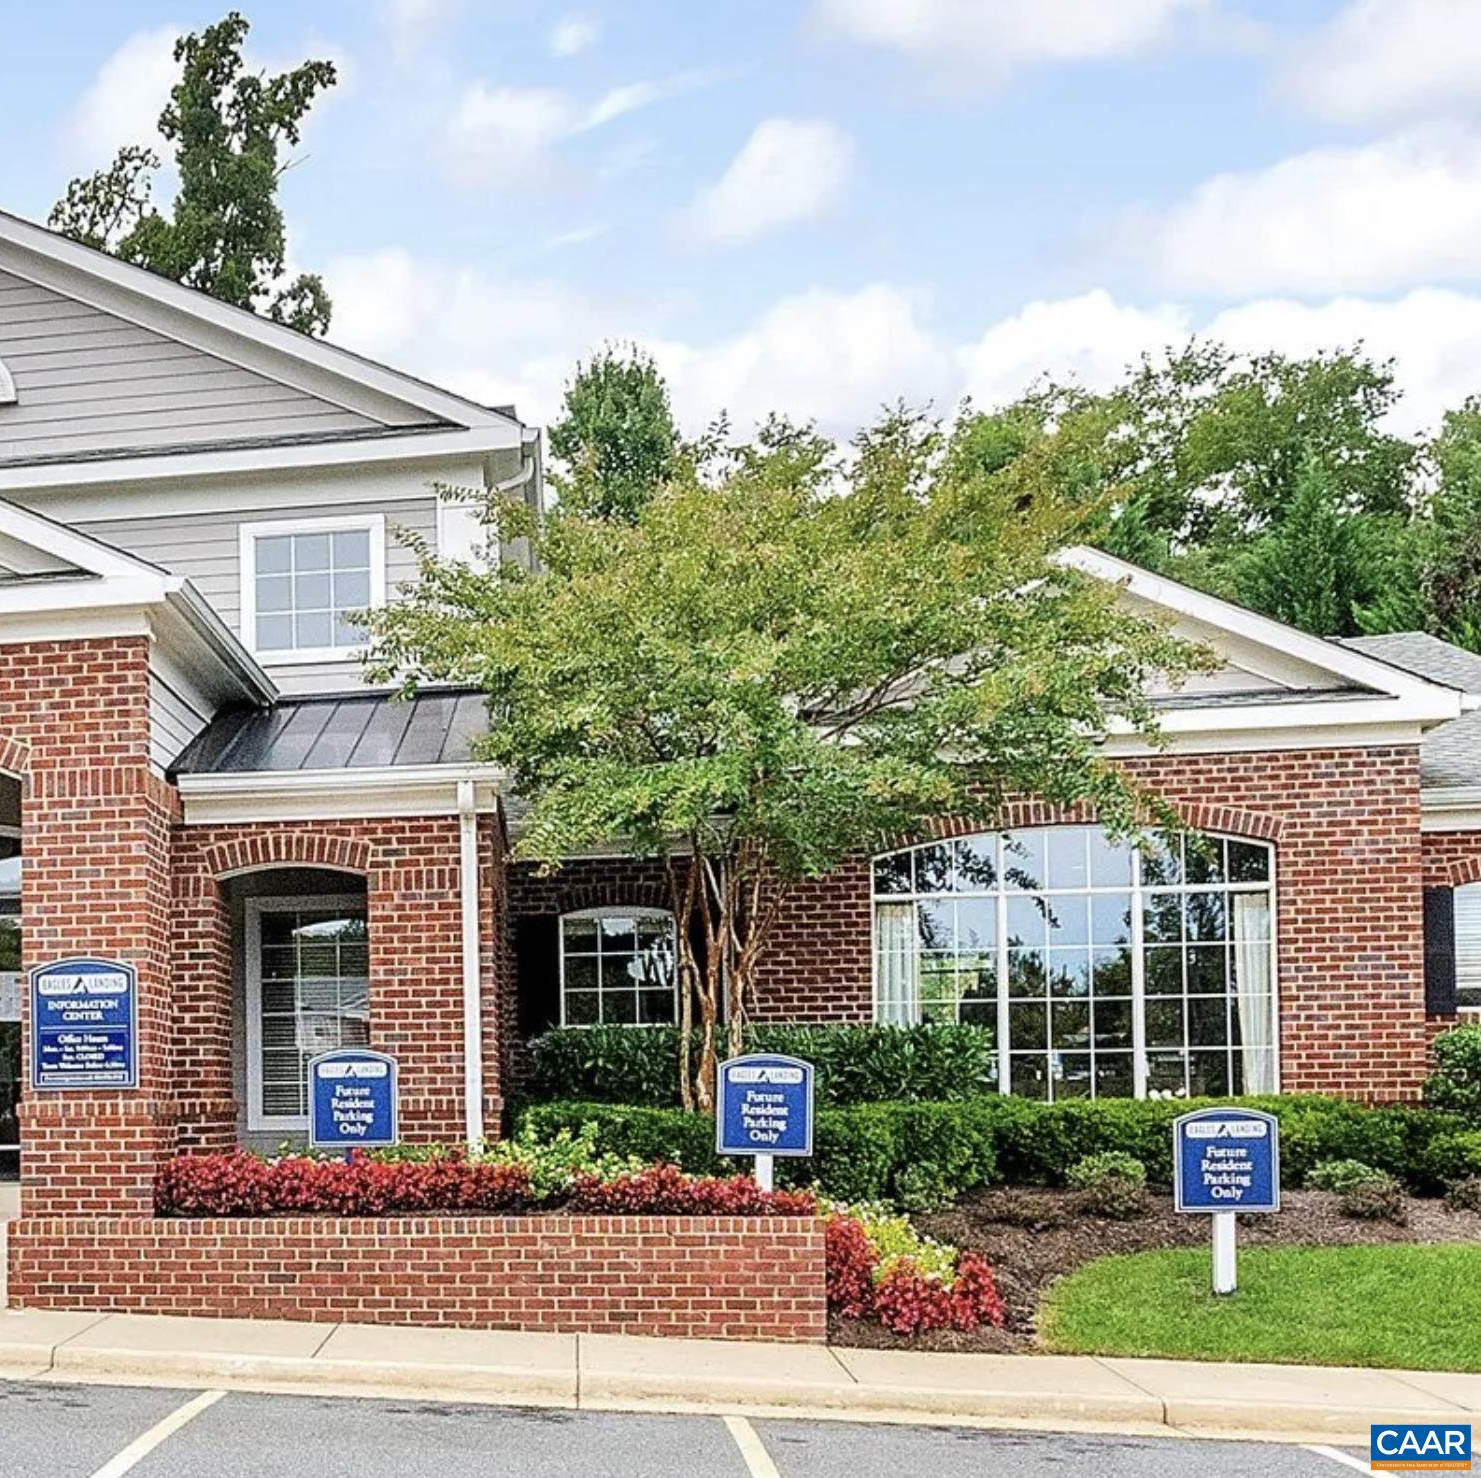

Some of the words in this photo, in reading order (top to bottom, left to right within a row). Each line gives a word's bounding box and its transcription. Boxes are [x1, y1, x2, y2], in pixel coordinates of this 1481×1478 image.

[47, 999, 119, 1010] INFORMATION
[62, 1010, 104, 1020] CENTER
[335, 1085, 371, 1096] Future
[746, 1090, 784, 1102] Future
[331, 1098, 375, 1109] Resident
[741, 1103, 789, 1116] Resident
[333, 1110, 374, 1123] Parking
[339, 1122, 367, 1136] Only
[743, 1116, 787, 1131] Parking
[749, 1129, 779, 1144] Only
[1206, 1145, 1247, 1158] Future
[1201, 1159, 1253, 1171] Resident
[1203, 1172, 1252, 1187] Parking
[1210, 1185, 1244, 1201] Only
